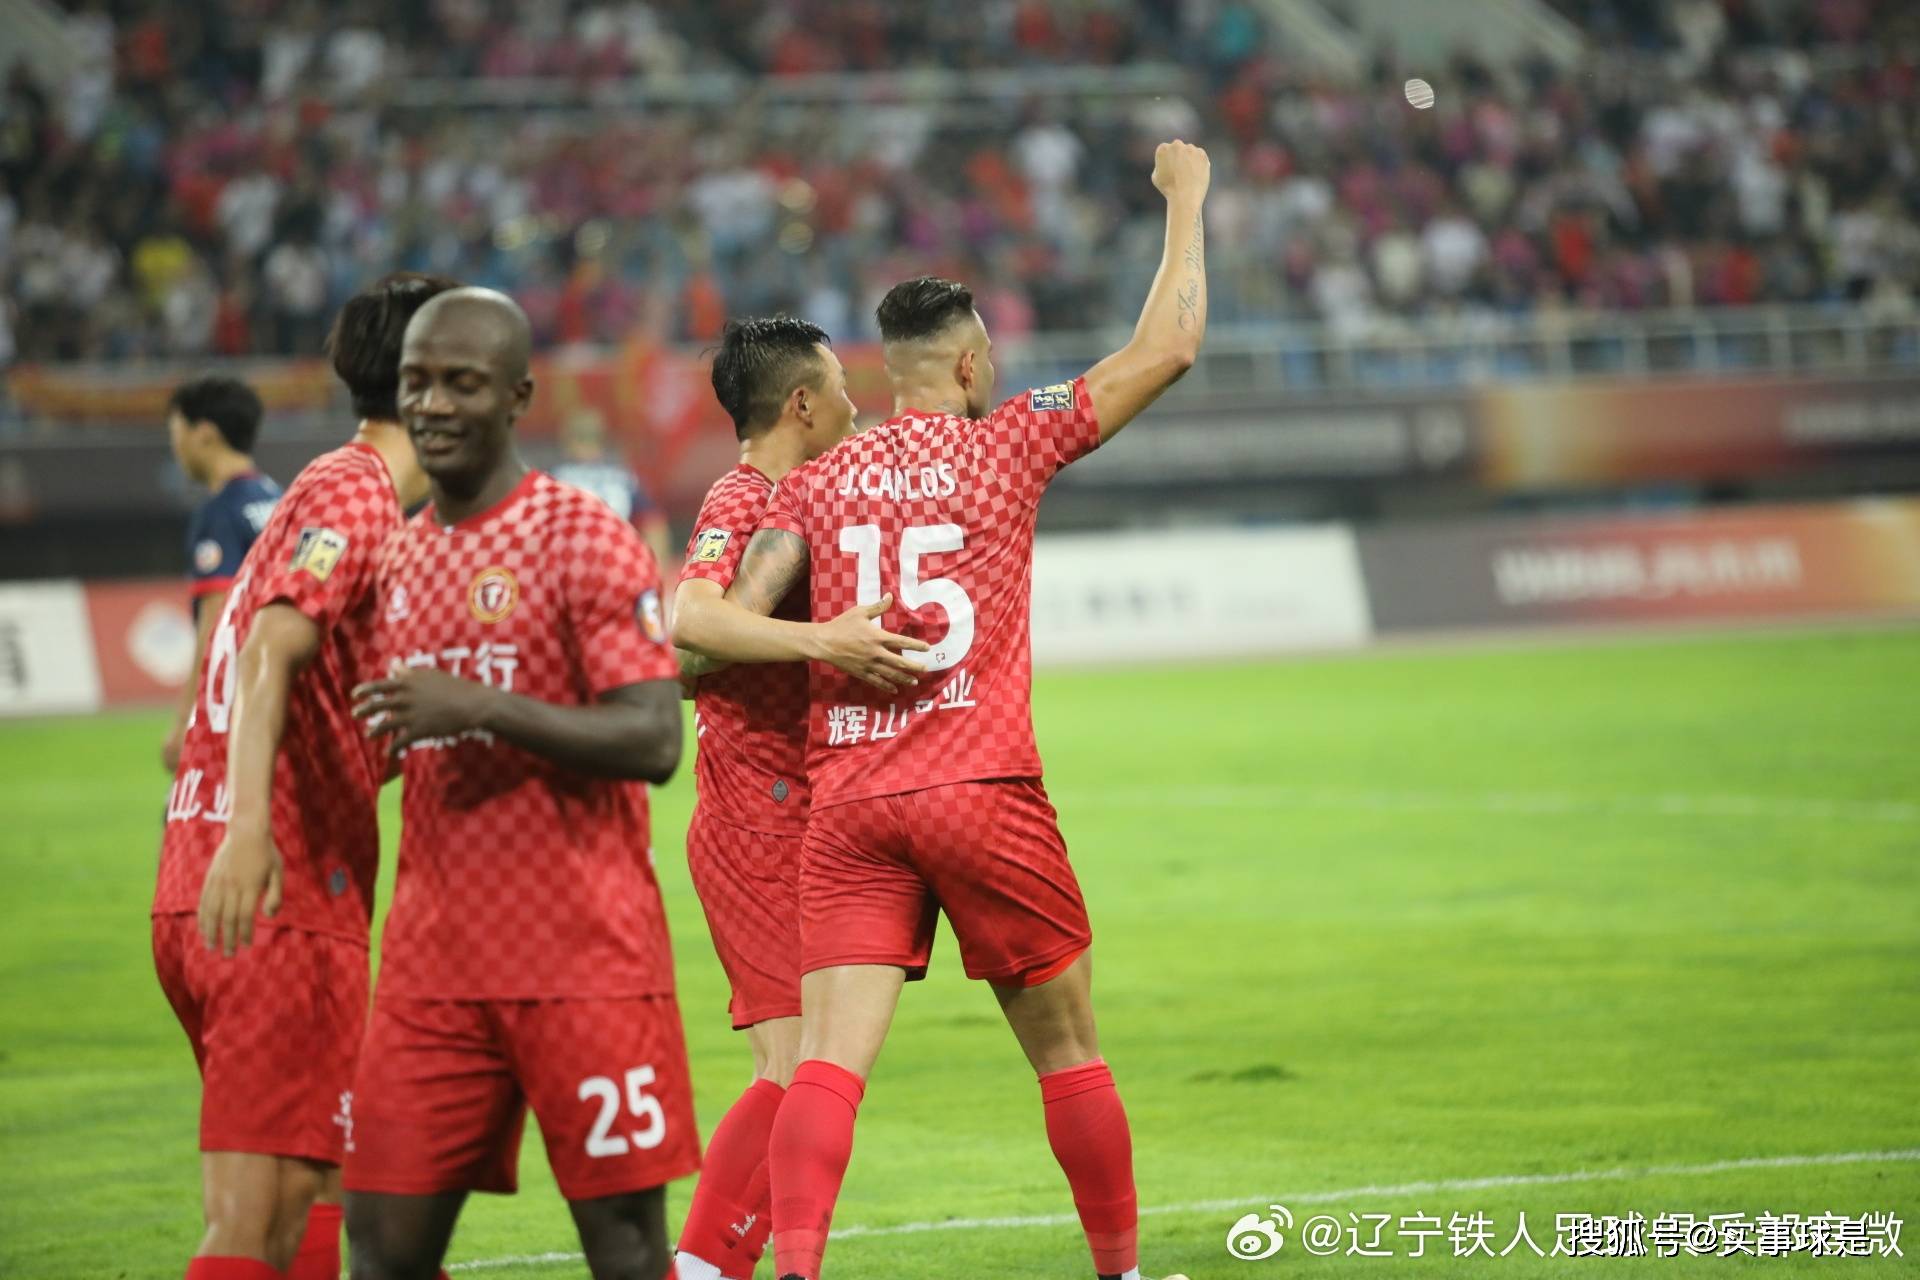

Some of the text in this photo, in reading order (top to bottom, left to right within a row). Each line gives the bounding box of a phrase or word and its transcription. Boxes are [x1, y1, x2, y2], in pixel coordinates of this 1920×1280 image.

[839, 523, 975, 673] 15
[827, 668, 977, 746] 辉山业
[577, 1065, 666, 1158] 25
